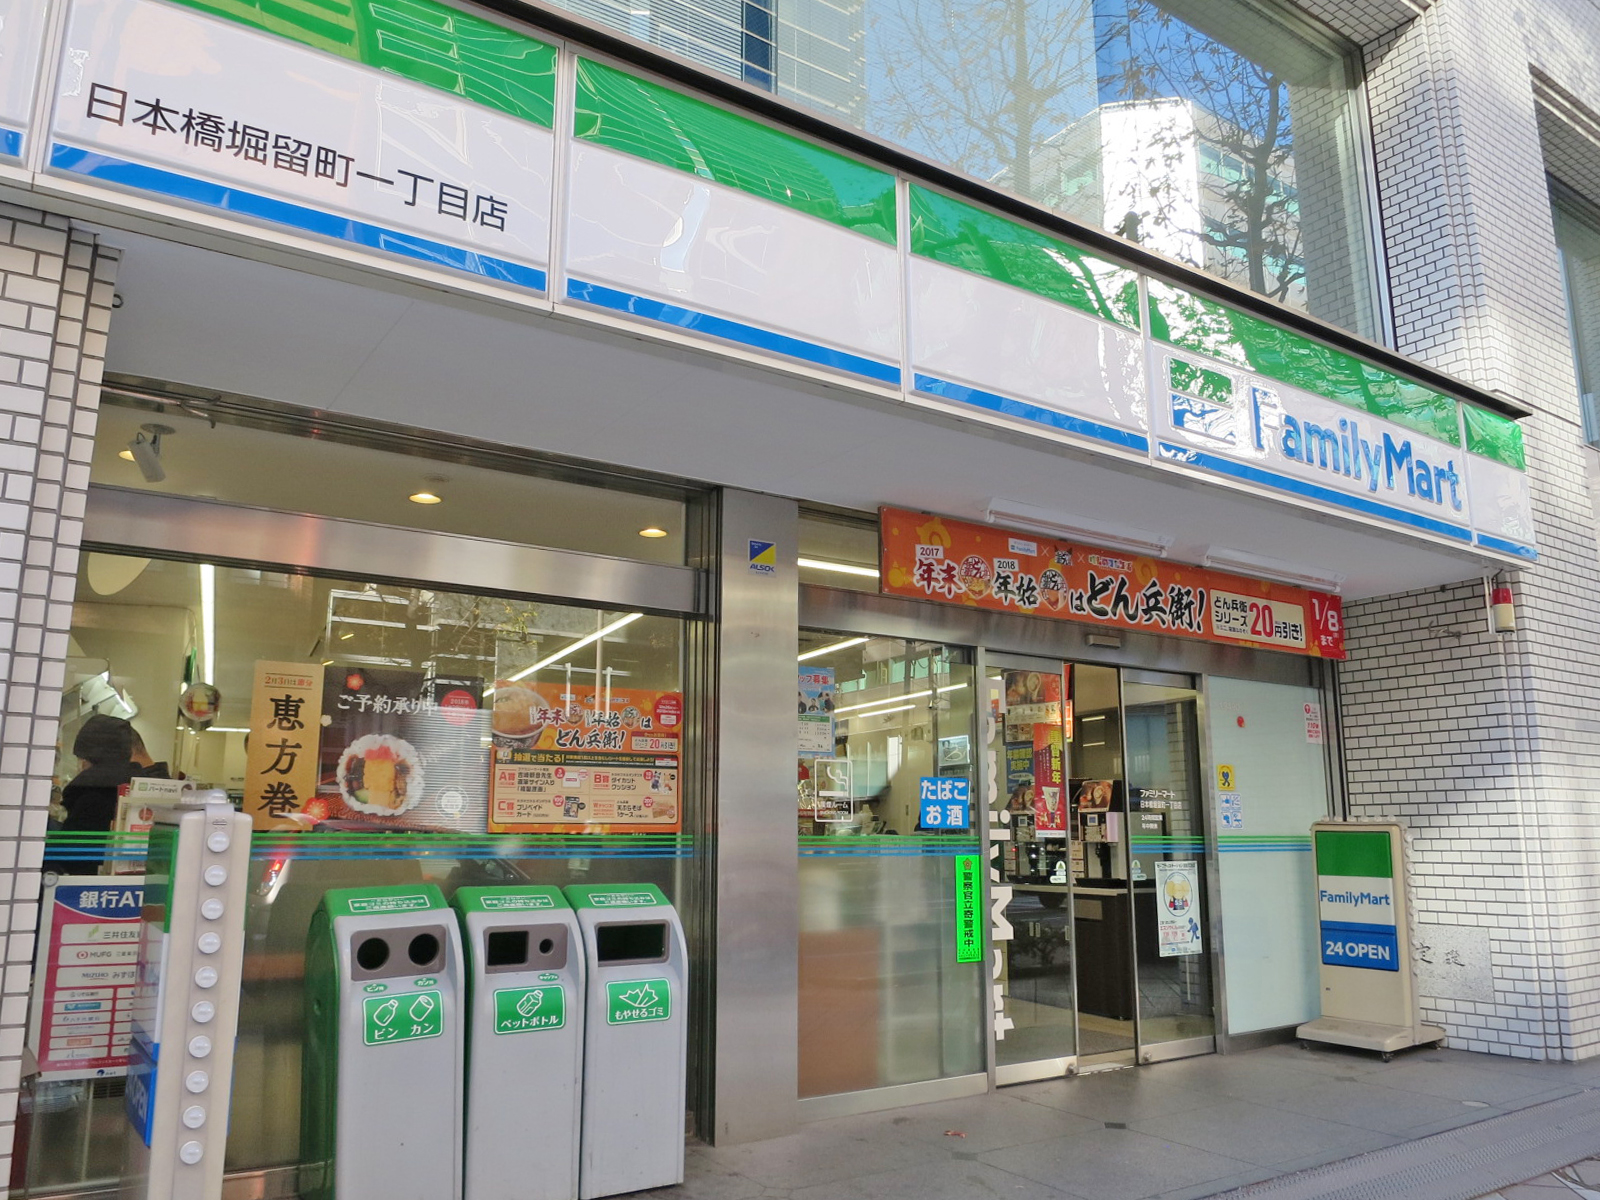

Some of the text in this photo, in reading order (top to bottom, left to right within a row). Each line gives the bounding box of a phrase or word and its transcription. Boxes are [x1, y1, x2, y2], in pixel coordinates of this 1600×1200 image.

[87, 82, 508, 232] 日本橋堀留町一丁目店
[1252, 386, 1463, 511] FamilyMart
[919, 546, 940, 557] 2017
[750, 563, 775, 573] ALSOK
[997, 559, 1016, 570] 2018
[916, 559, 963, 597] 年末
[994, 571, 1039, 606] 年始
[1214, 596, 1247, 613] どん兵衛
[1215, 611, 1248, 627] シリーズ
[1320, 635, 1334, 647] まで
[555, 729, 625, 750] どん兵衛!
[257, 694, 305, 818] 恵方巻
[921, 780, 967, 800] たばこ
[1140, 789, 1176, 799] ファミリーマート
[926, 804, 963, 826] お酒
[1320, 890, 1390, 907] FamilyMart
[963, 871, 974, 948] 警察官立寄警戒中
[103, 931, 139, 940] 三井住友
[1325, 941, 1390, 960] 24 OPEN
[615, 1006, 664, 1020] もやせるゴミ
[501, 1015, 559, 1029] ペットボトル
[375, 1023, 434, 1039] ビン カン
